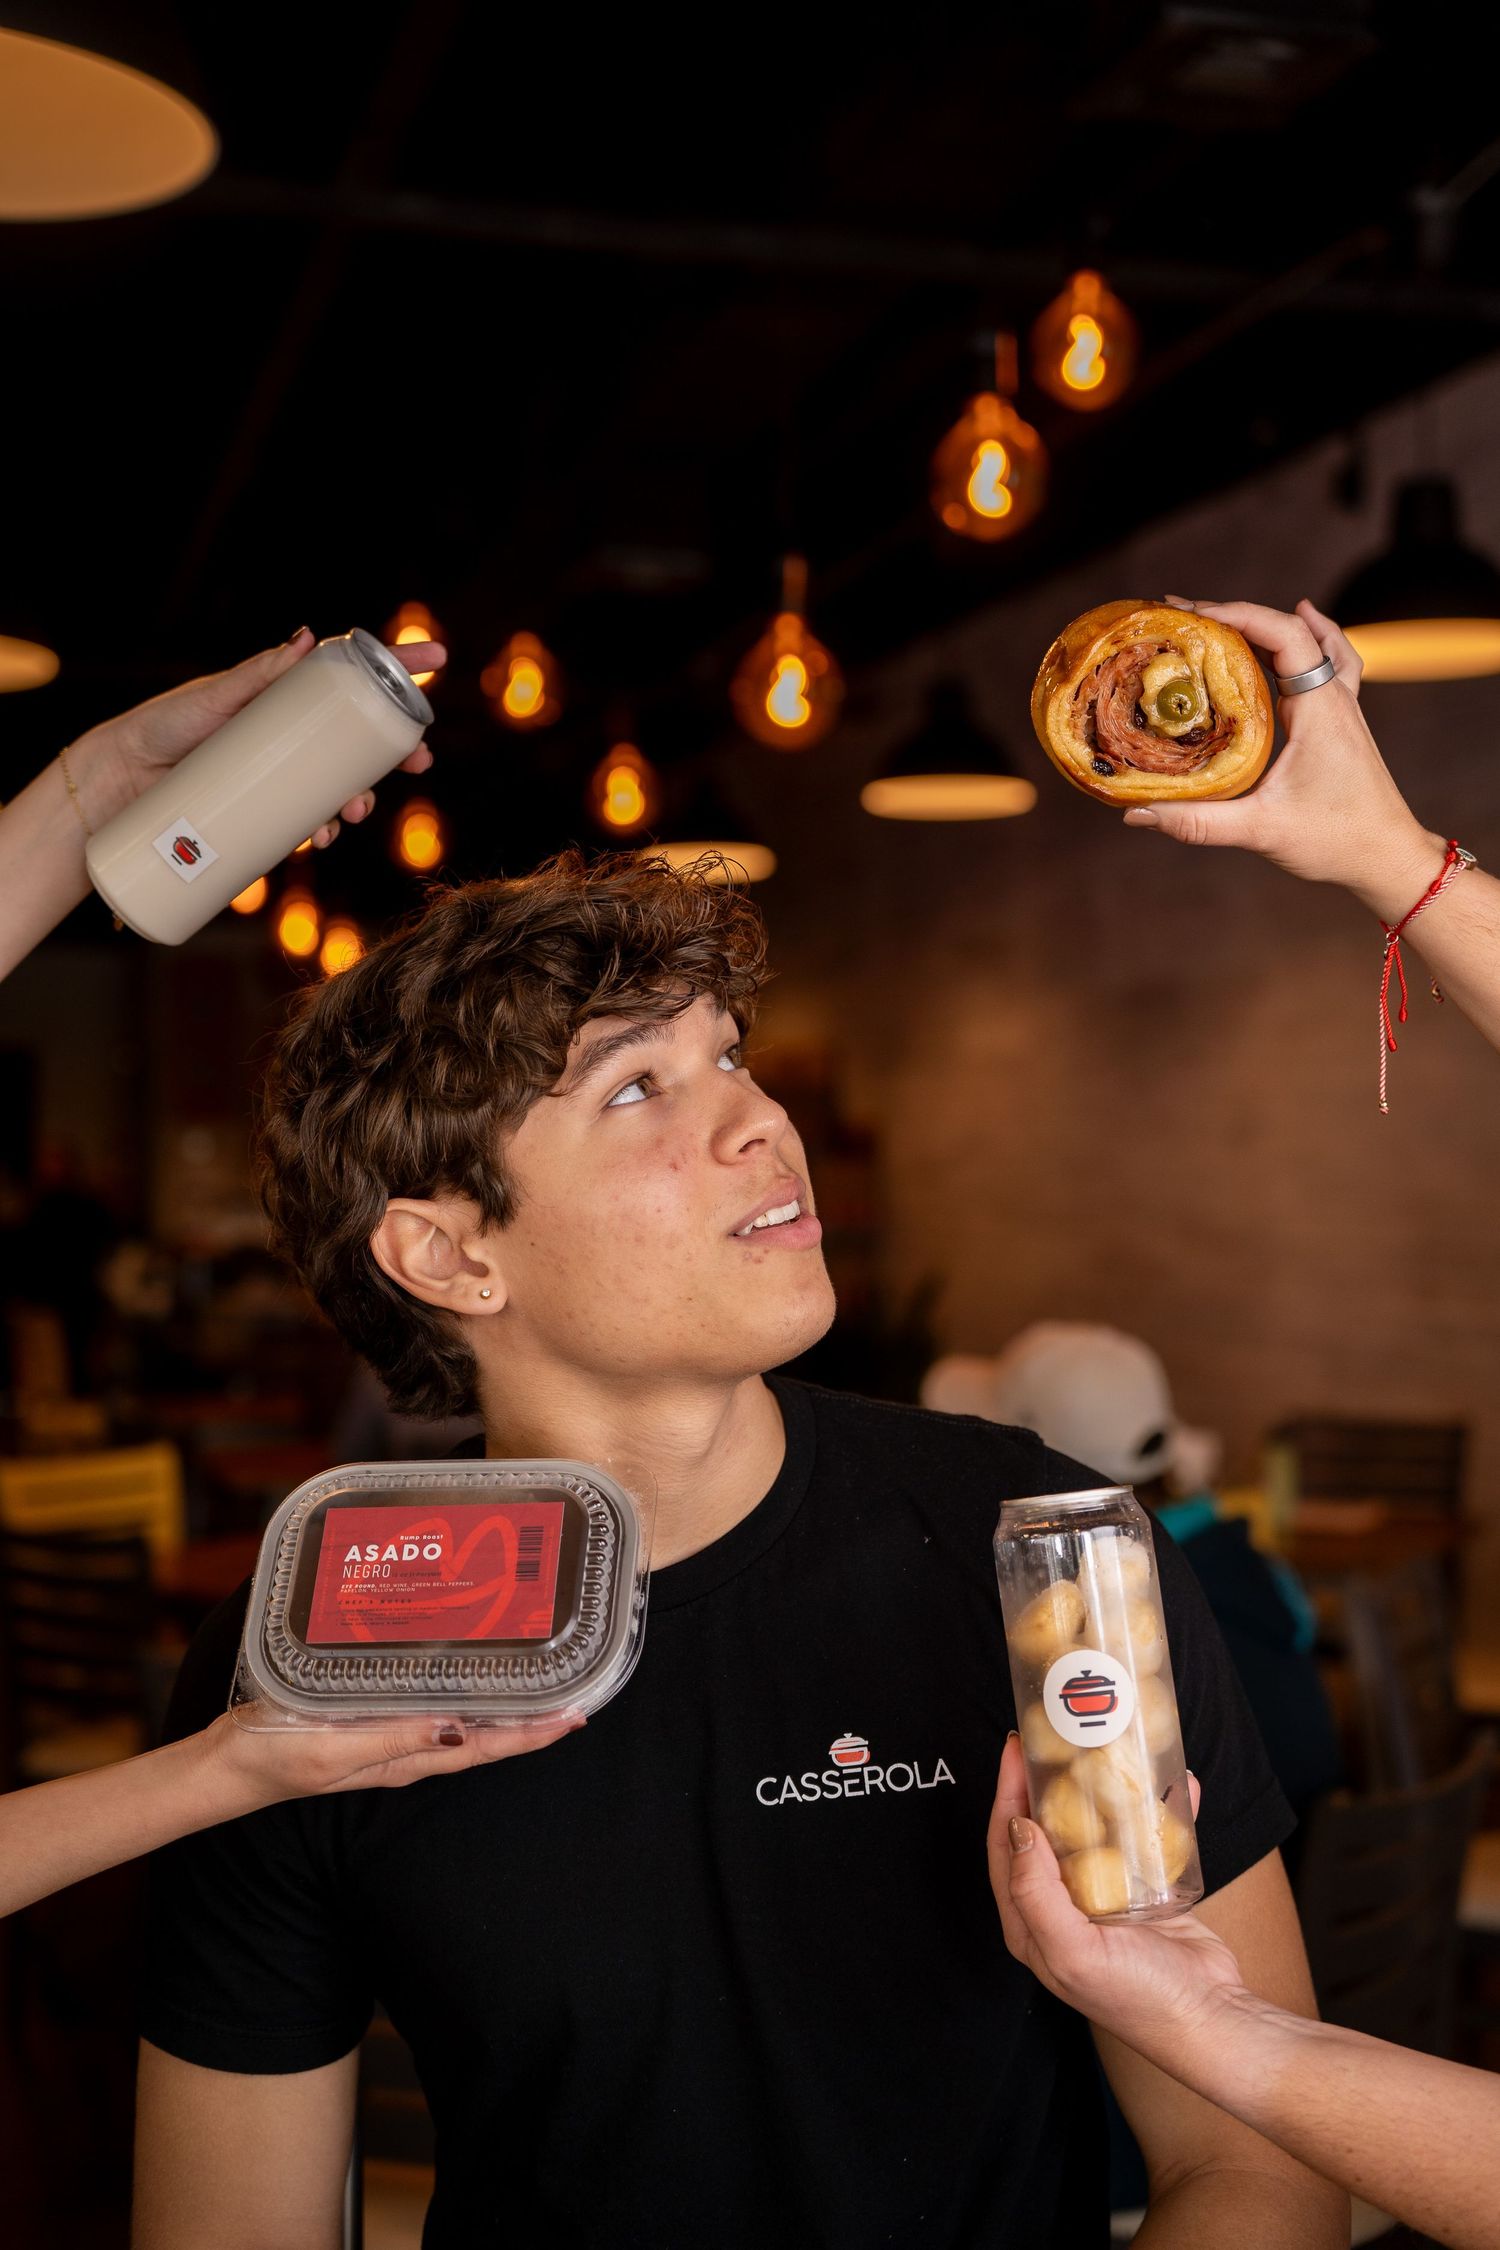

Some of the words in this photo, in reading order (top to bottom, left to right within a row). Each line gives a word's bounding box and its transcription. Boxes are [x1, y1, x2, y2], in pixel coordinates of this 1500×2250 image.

[343, 1543, 442, 1562] ASADO
[342, 1564, 391, 1578] NEGRO
[756, 1758, 956, 1806] CASSEROLA
